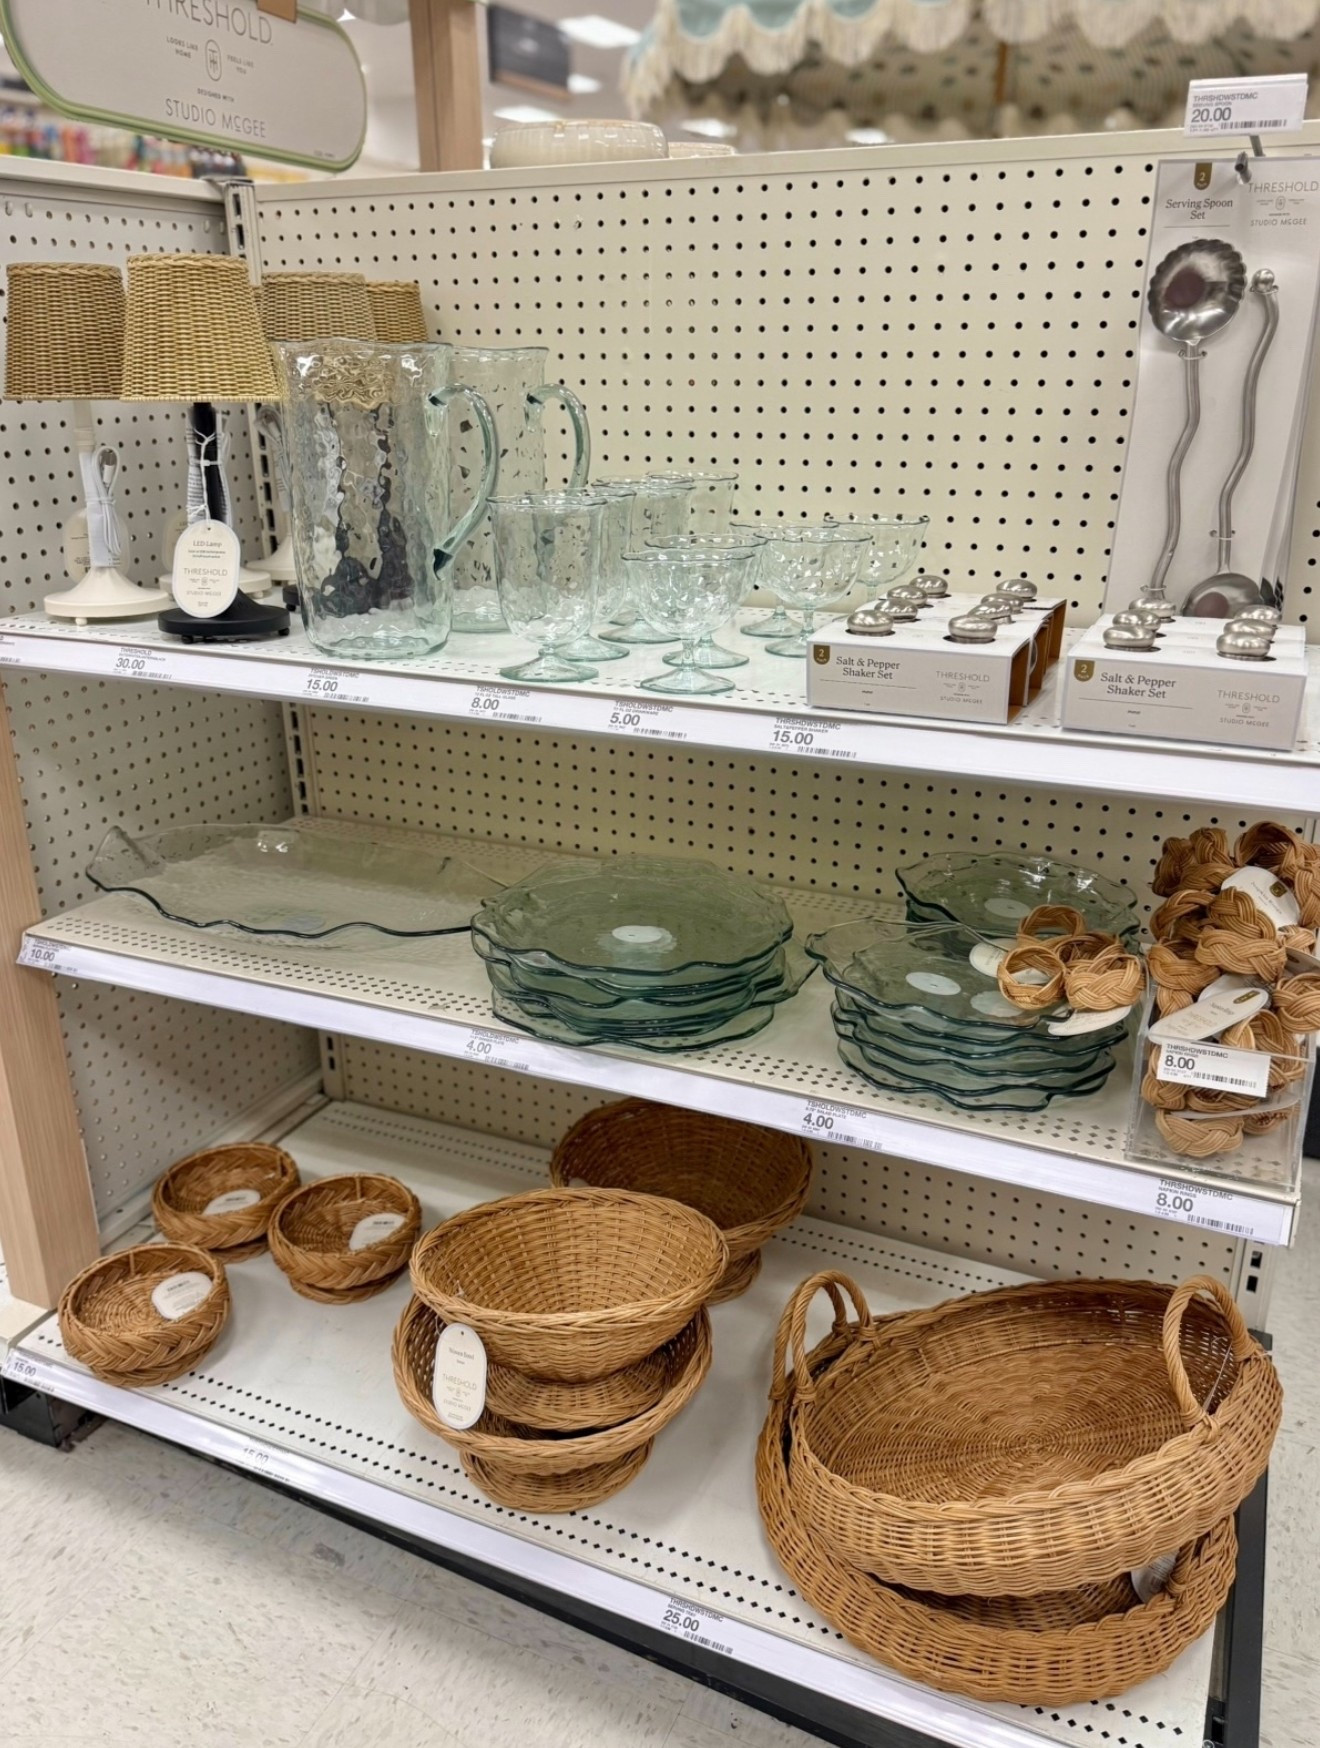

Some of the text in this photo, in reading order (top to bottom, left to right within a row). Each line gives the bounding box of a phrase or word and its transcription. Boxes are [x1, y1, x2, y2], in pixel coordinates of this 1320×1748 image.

[147, 0, 272, 44] RESHOLD
[165, 98, 216, 126] STUDIO
[1191, 107, 1232, 123] 20.00
[1199, 171, 1206, 182] 2
[1248, 181, 1319, 193] THRESHOLD
[1165, 198, 1233, 211] Serving Spoon
[1190, 210, 1206, 220] Set
[1250, 218, 1278, 227] STUDIO
[183, 567, 228, 577] THRESHOLD
[819, 648, 825, 657] 2
[116, 657, 146, 670] 30.00
[836, 656, 855, 666] Salt
[856, 658, 865, 667] &
[867, 658, 900, 670] Pepper
[1080, 664, 1088, 673] 2
[842, 667, 893, 680] Shaker Set
[936, 670, 990, 682] THRESHOLD
[1100, 672, 1122, 683] Salt
[1124, 674, 1135, 684] &
[1137, 675, 1177, 689] Pepper
[306, 678, 338, 692] 15.00
[1107, 684, 1167, 699] Shaker Set
[1217, 689, 1280, 703] THRESHOLD
[471, 697, 499, 710] 8.00
[609, 712, 640, 726] 5.00
[773, 730, 814, 745] 15.00
[30, 949, 55, 962] 10.00
[466, 1039, 492, 1054] 4.00
[1165, 1055, 1195, 1070] 8.00
[803, 1112, 834, 1129] 4.00
[1156, 1192, 1193, 1212] 8.00
[663, 1609, 700, 1632] 25.00
